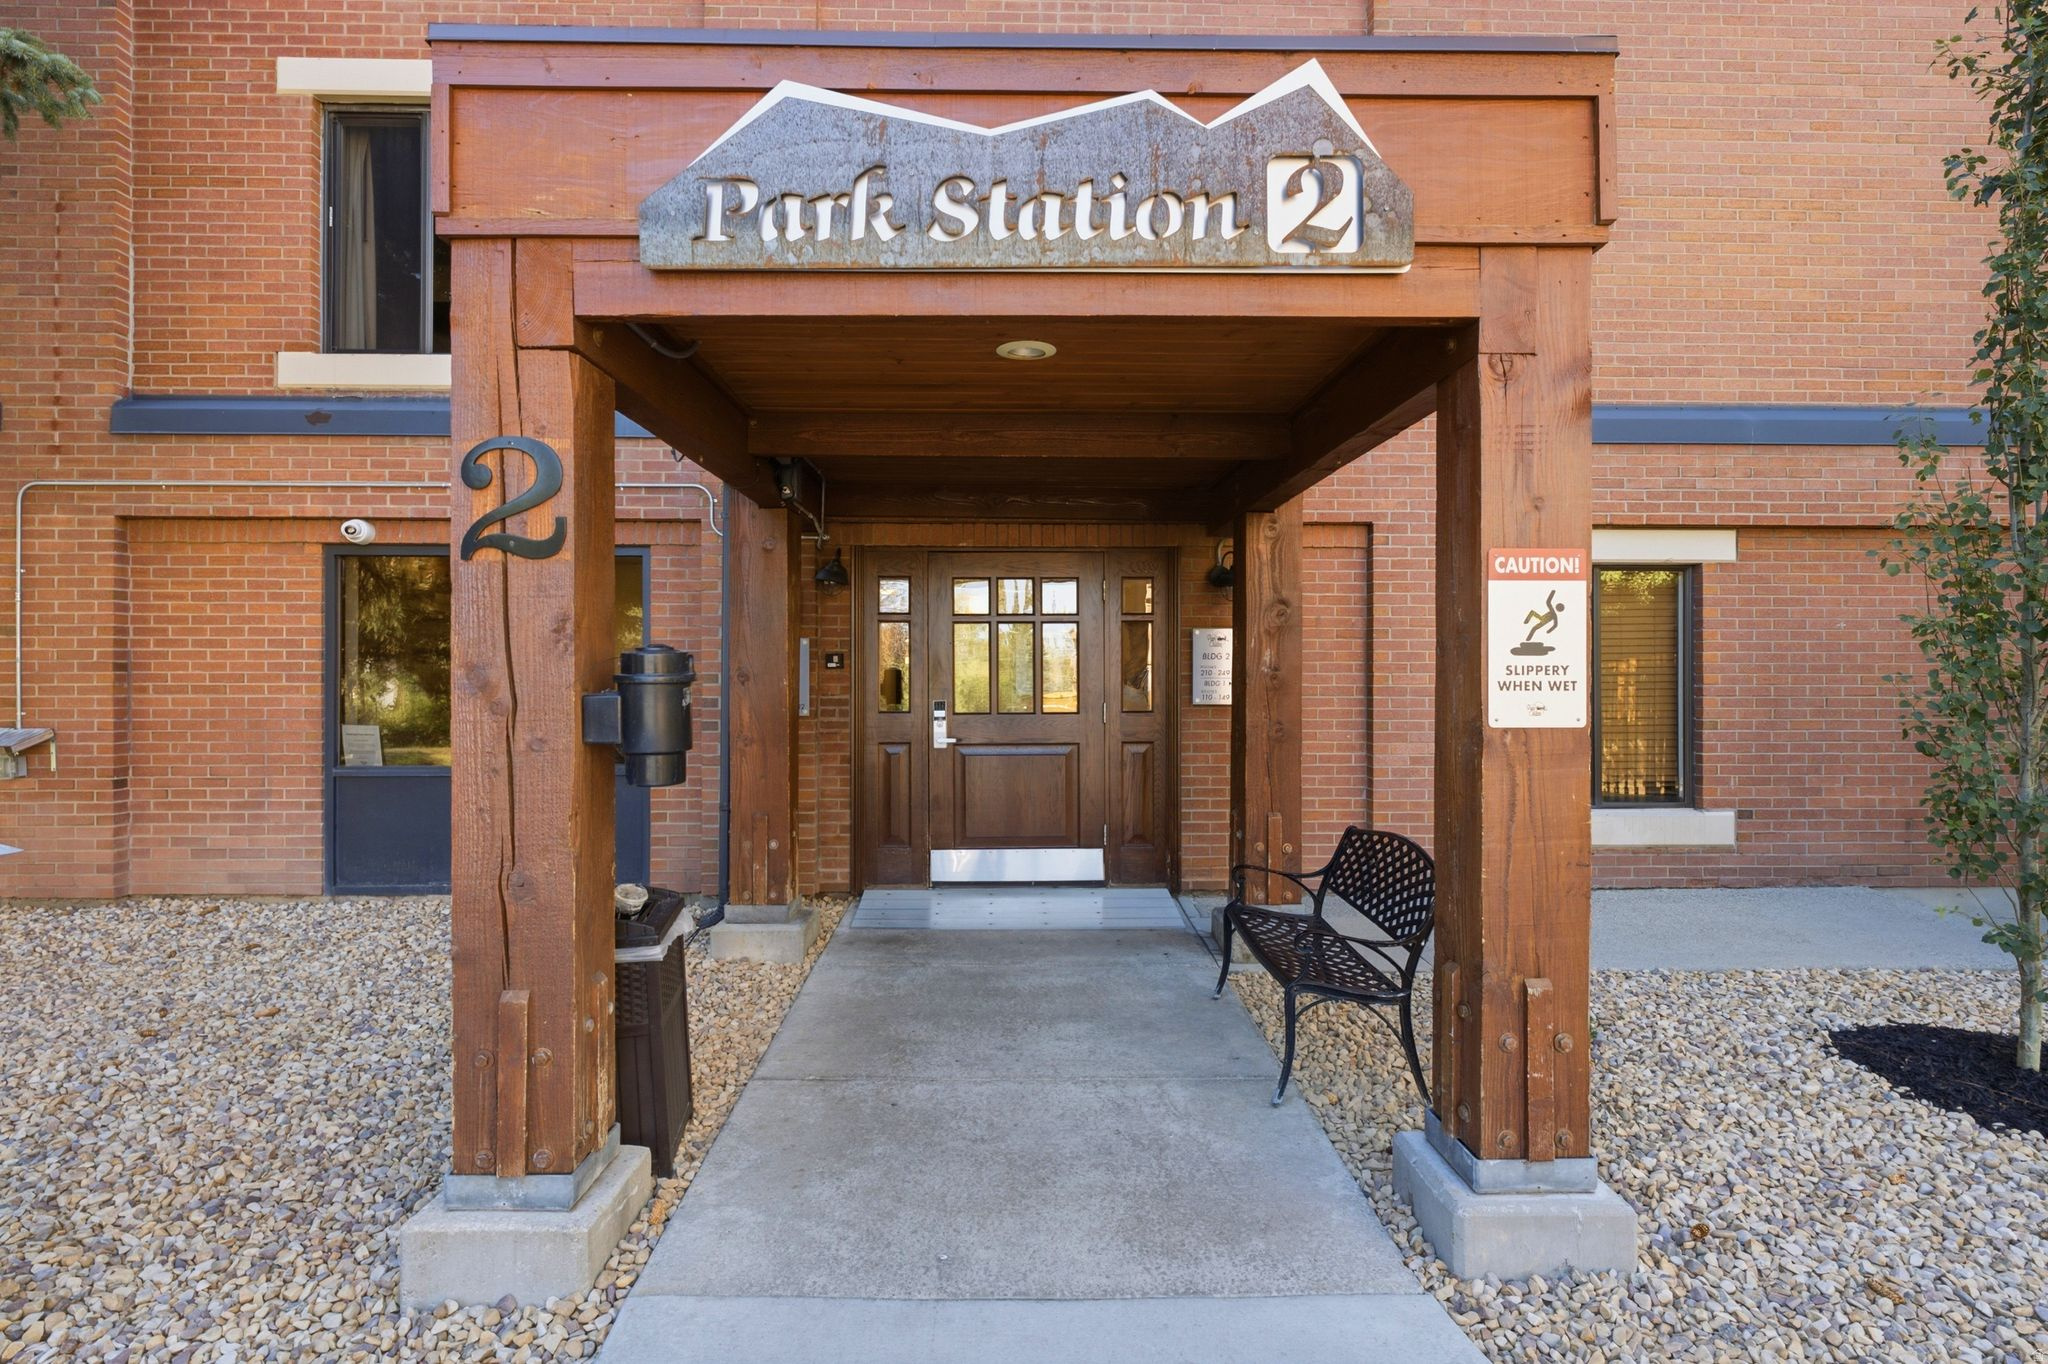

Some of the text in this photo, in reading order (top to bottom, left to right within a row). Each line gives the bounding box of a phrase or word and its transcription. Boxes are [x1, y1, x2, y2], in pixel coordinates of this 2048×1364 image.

[691, 156, 1355, 249] Park Station 2
[460, 435, 567, 561] 2
[1494, 556, 1580, 574] CAUTION!
[1505, 665, 1570, 676] SLIPPERY
[1497, 680, 1578, 691] WHEN WET
